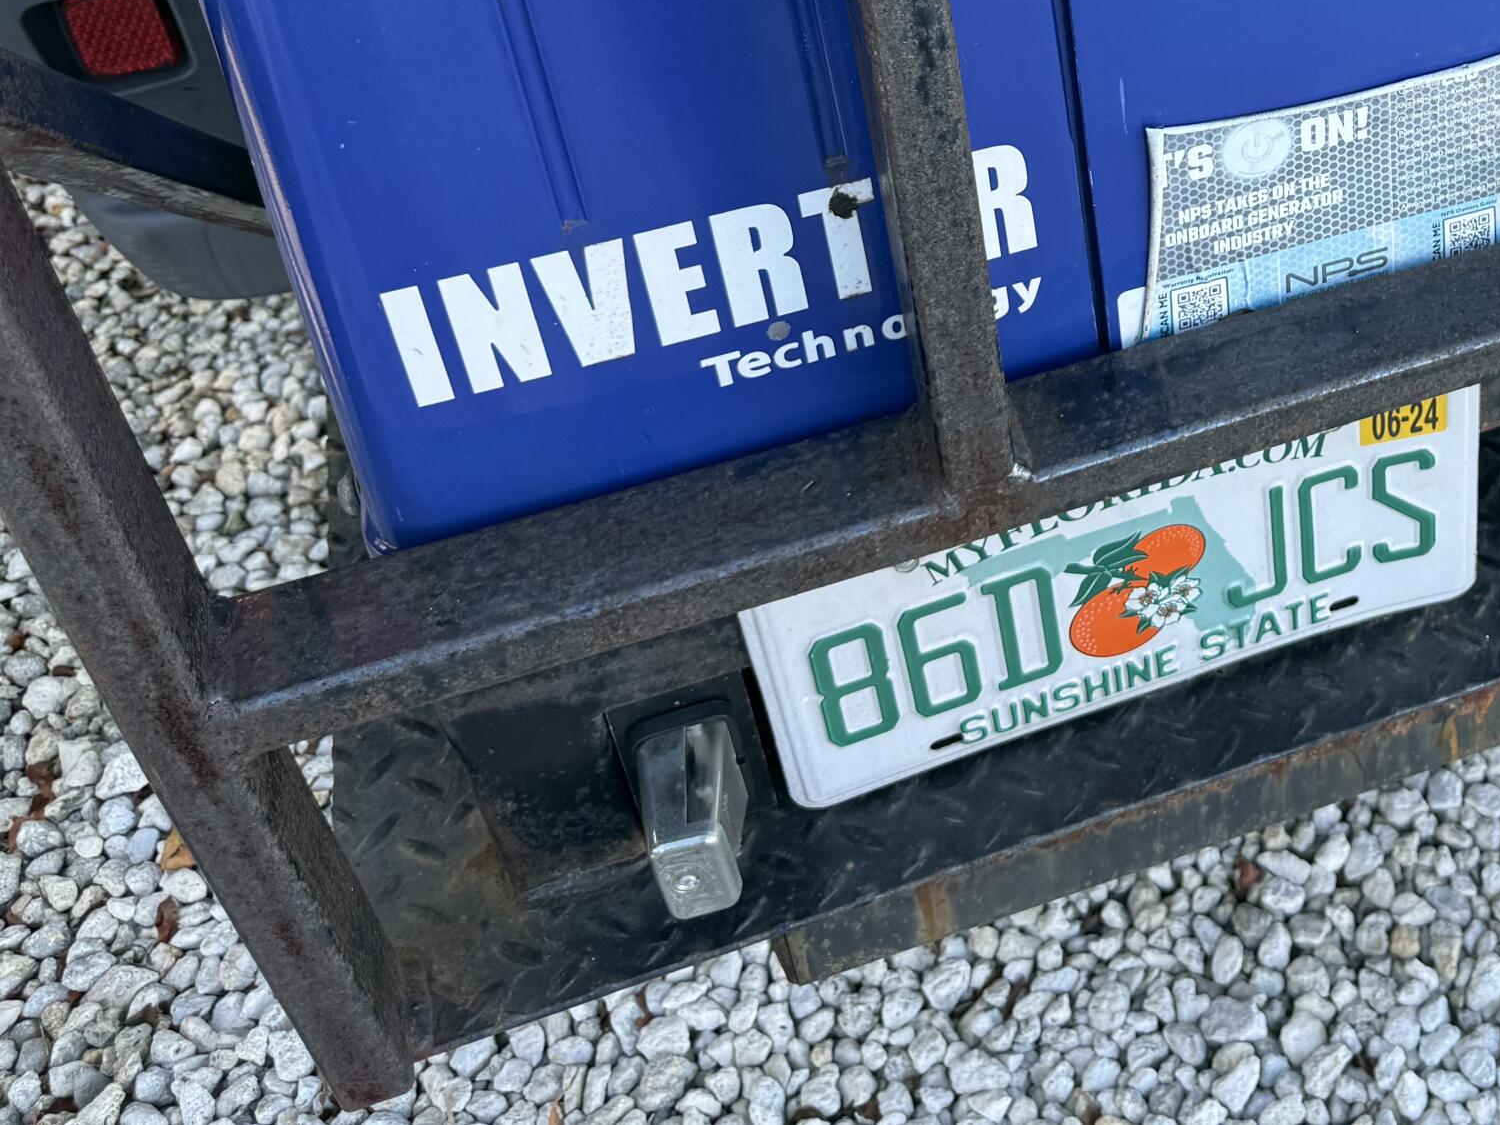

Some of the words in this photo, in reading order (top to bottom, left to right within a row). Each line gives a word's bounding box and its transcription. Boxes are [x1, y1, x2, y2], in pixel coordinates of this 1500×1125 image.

[1300, 106, 1369, 152] ON!
[1165, 215, 1244, 247] ONBOARD
[1247, 189, 1344, 226] GENERATOR
[1178, 203, 1212, 224] NPS
[1216, 188, 1269, 213] TAKES
[1272, 181, 1296, 201] ON
[1299, 173, 1330, 192] THE
[1213, 221, 1296, 255] INDUSTRY
[1432, 220, 1441, 236] ME
[380, 145, 1038, 408] INVERTR
[1162, 277, 1194, 290] Warranty
[1195, 268, 1234, 282] Registration
[1285, 245, 1389, 293] NPS
[1158, 292, 1169, 311] ME
[1159, 312, 1170, 337] CAN
[700, 277, 1042, 387] Technogy
[1371, 396, 1440, 441] 06-24
[806, 563, 1063, 748] 86D
[1226, 448, 1436, 608] JCS
[958, 644, 1177, 744] SUNSHINE
[1200, 591, 1331, 663] STATE
